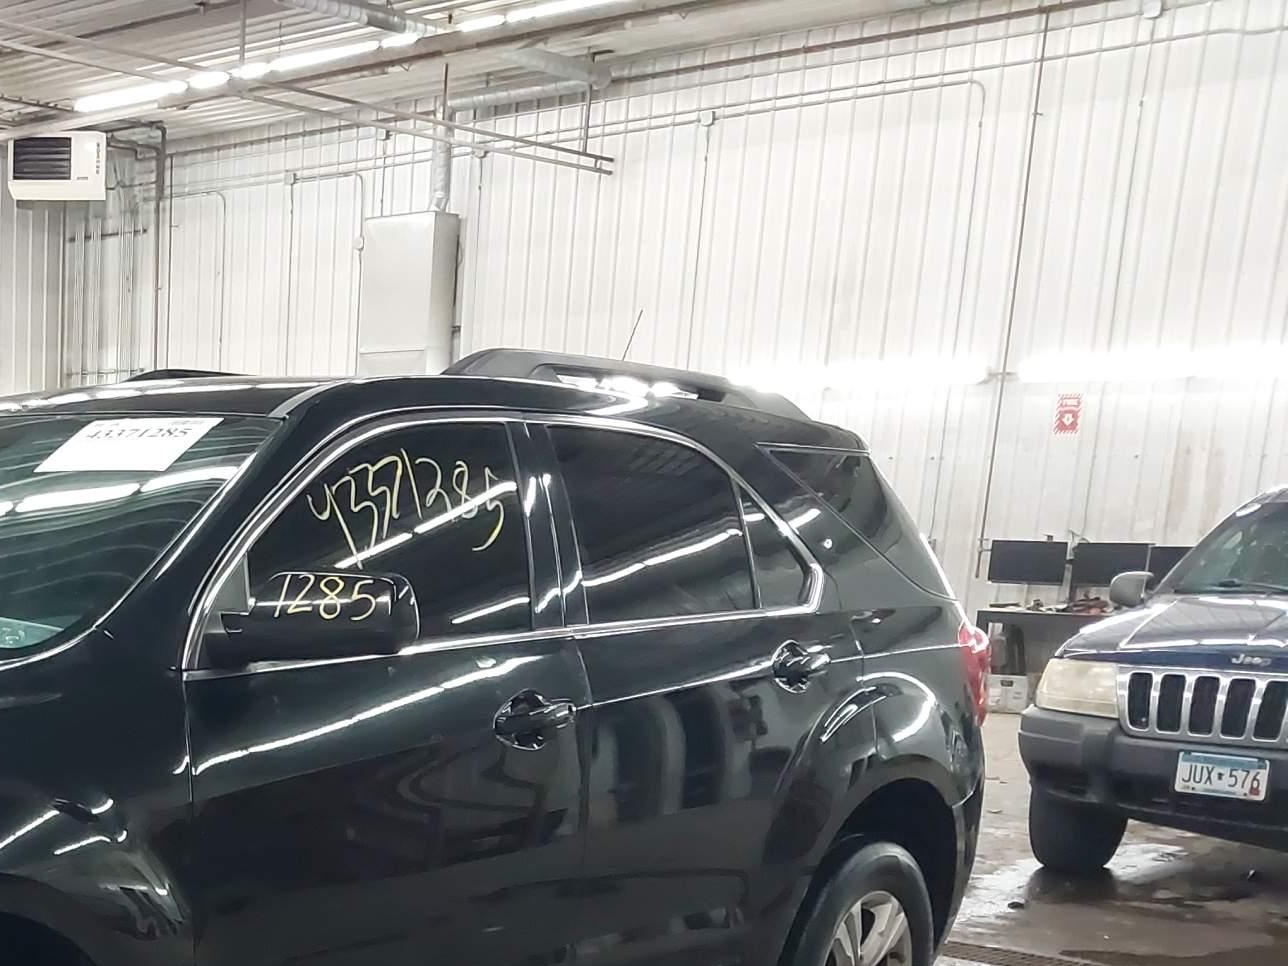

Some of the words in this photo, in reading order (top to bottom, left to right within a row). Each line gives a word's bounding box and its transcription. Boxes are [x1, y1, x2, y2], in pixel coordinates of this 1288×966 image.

[86, 427, 193, 440] 43371285
[1231, 653, 1273, 667] Jeep
[1181, 764, 1215, 785] JUX
